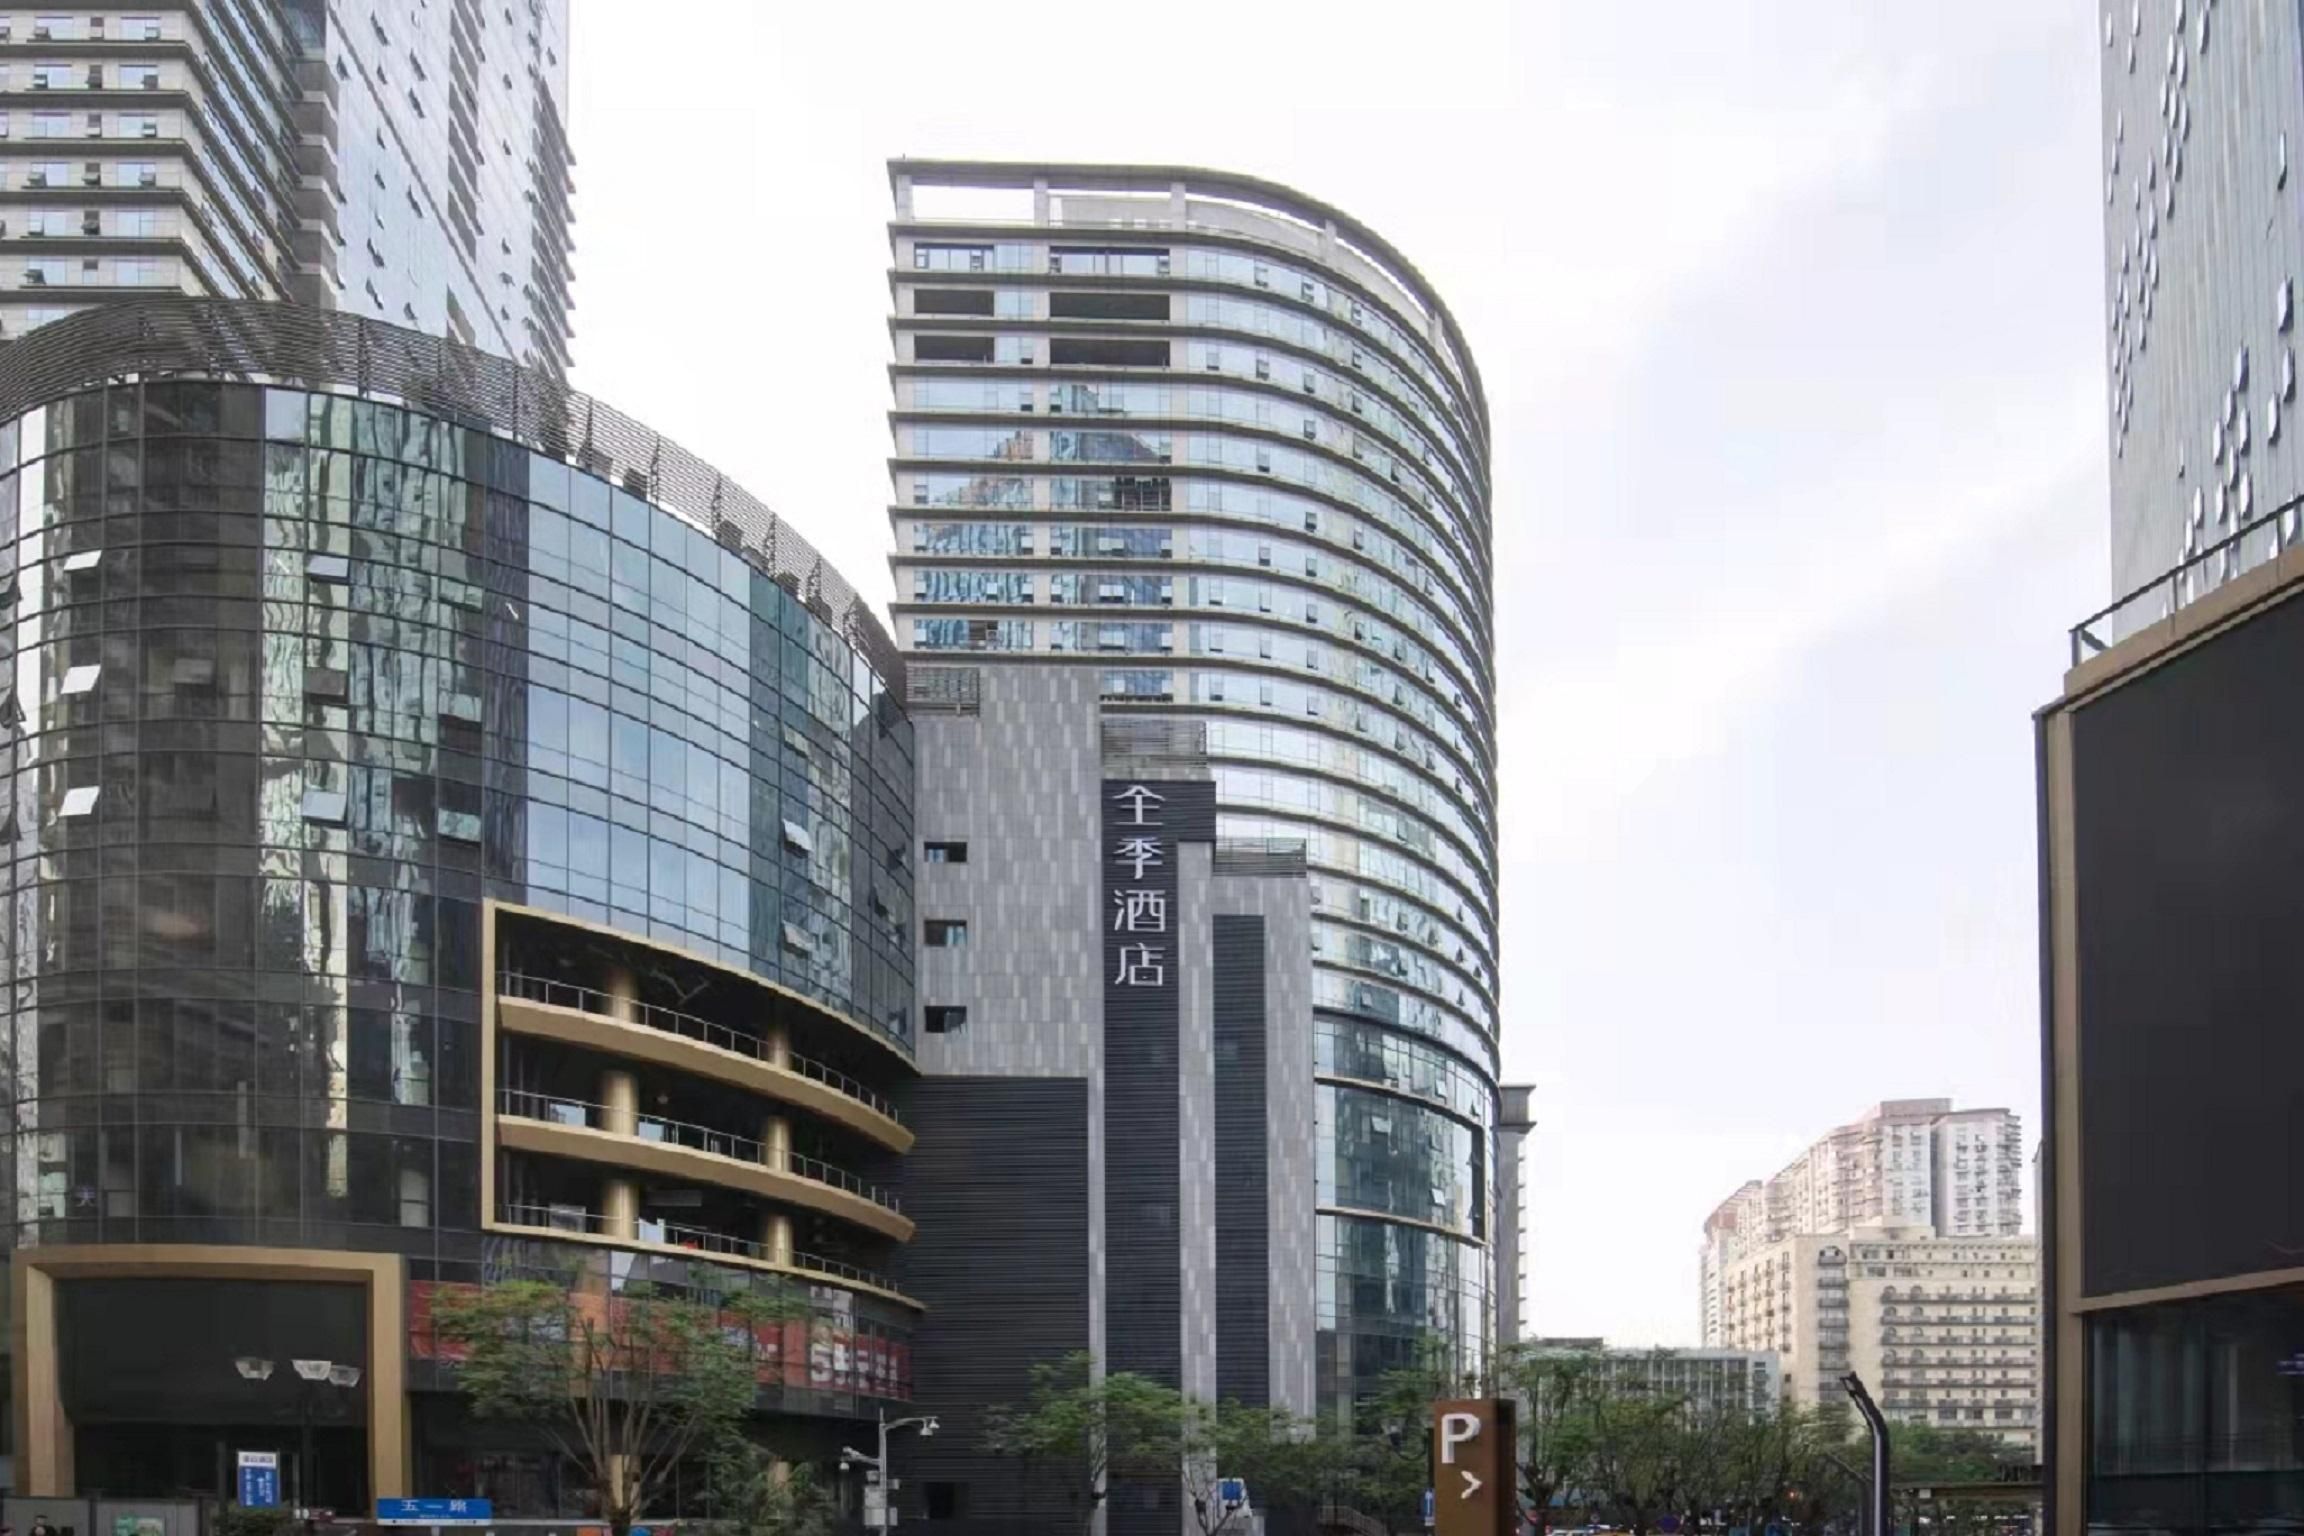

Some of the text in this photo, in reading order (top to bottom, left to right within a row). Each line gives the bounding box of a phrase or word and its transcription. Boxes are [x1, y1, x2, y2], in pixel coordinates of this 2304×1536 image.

[1112, 785, 1166, 986] 全季酒店
[1441, 1412, 1481, 1464] P
[400, 1499, 468, 1513] 五一路
